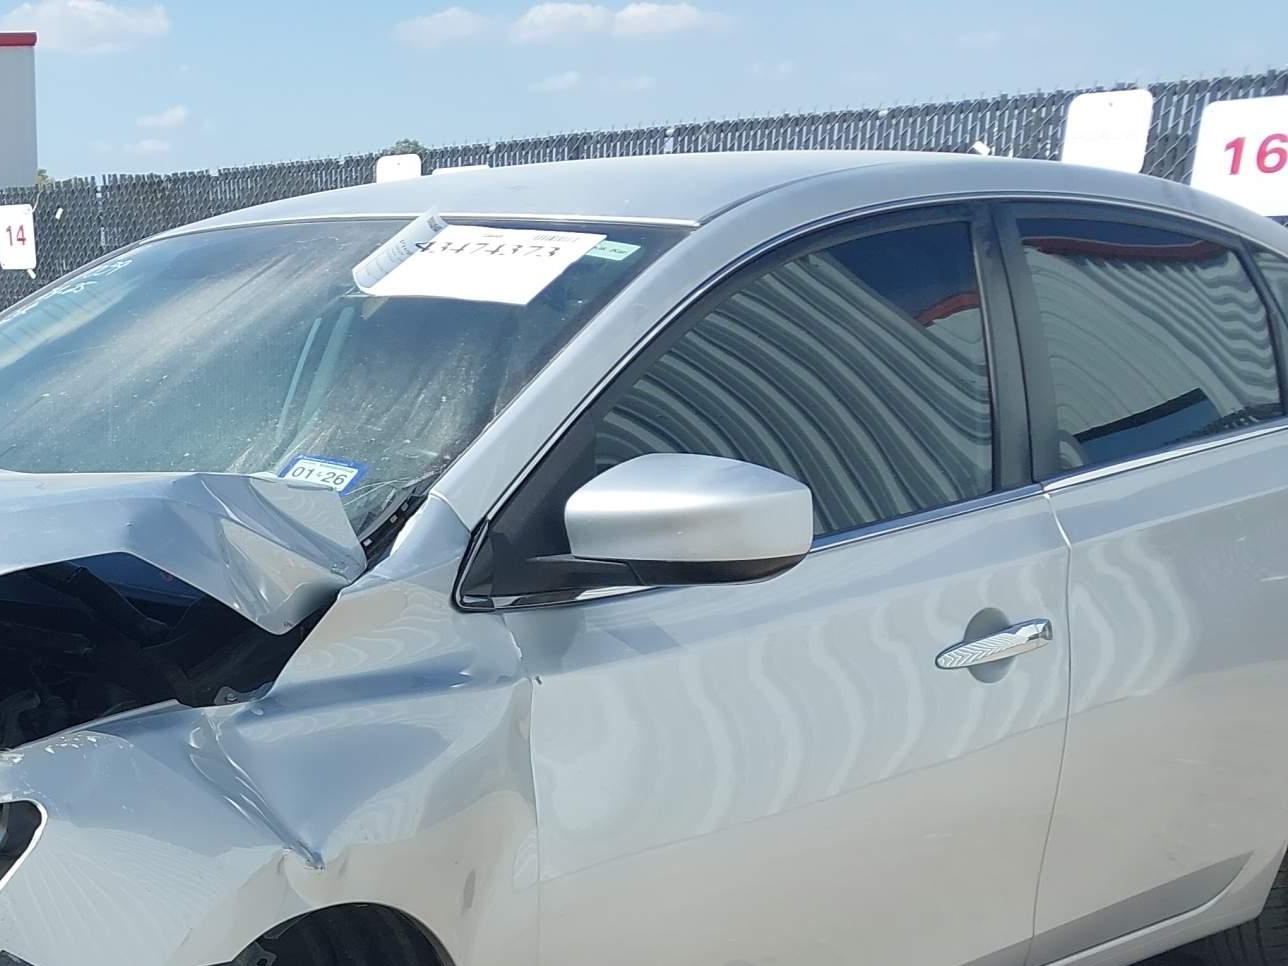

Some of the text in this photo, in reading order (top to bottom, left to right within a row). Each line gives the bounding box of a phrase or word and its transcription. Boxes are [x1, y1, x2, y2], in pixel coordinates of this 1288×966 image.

[1224, 133, 1288, 175] 16
[6, 224, 27, 247] 14
[292, 466, 315, 479] 01
[320, 471, 348, 486] 26
